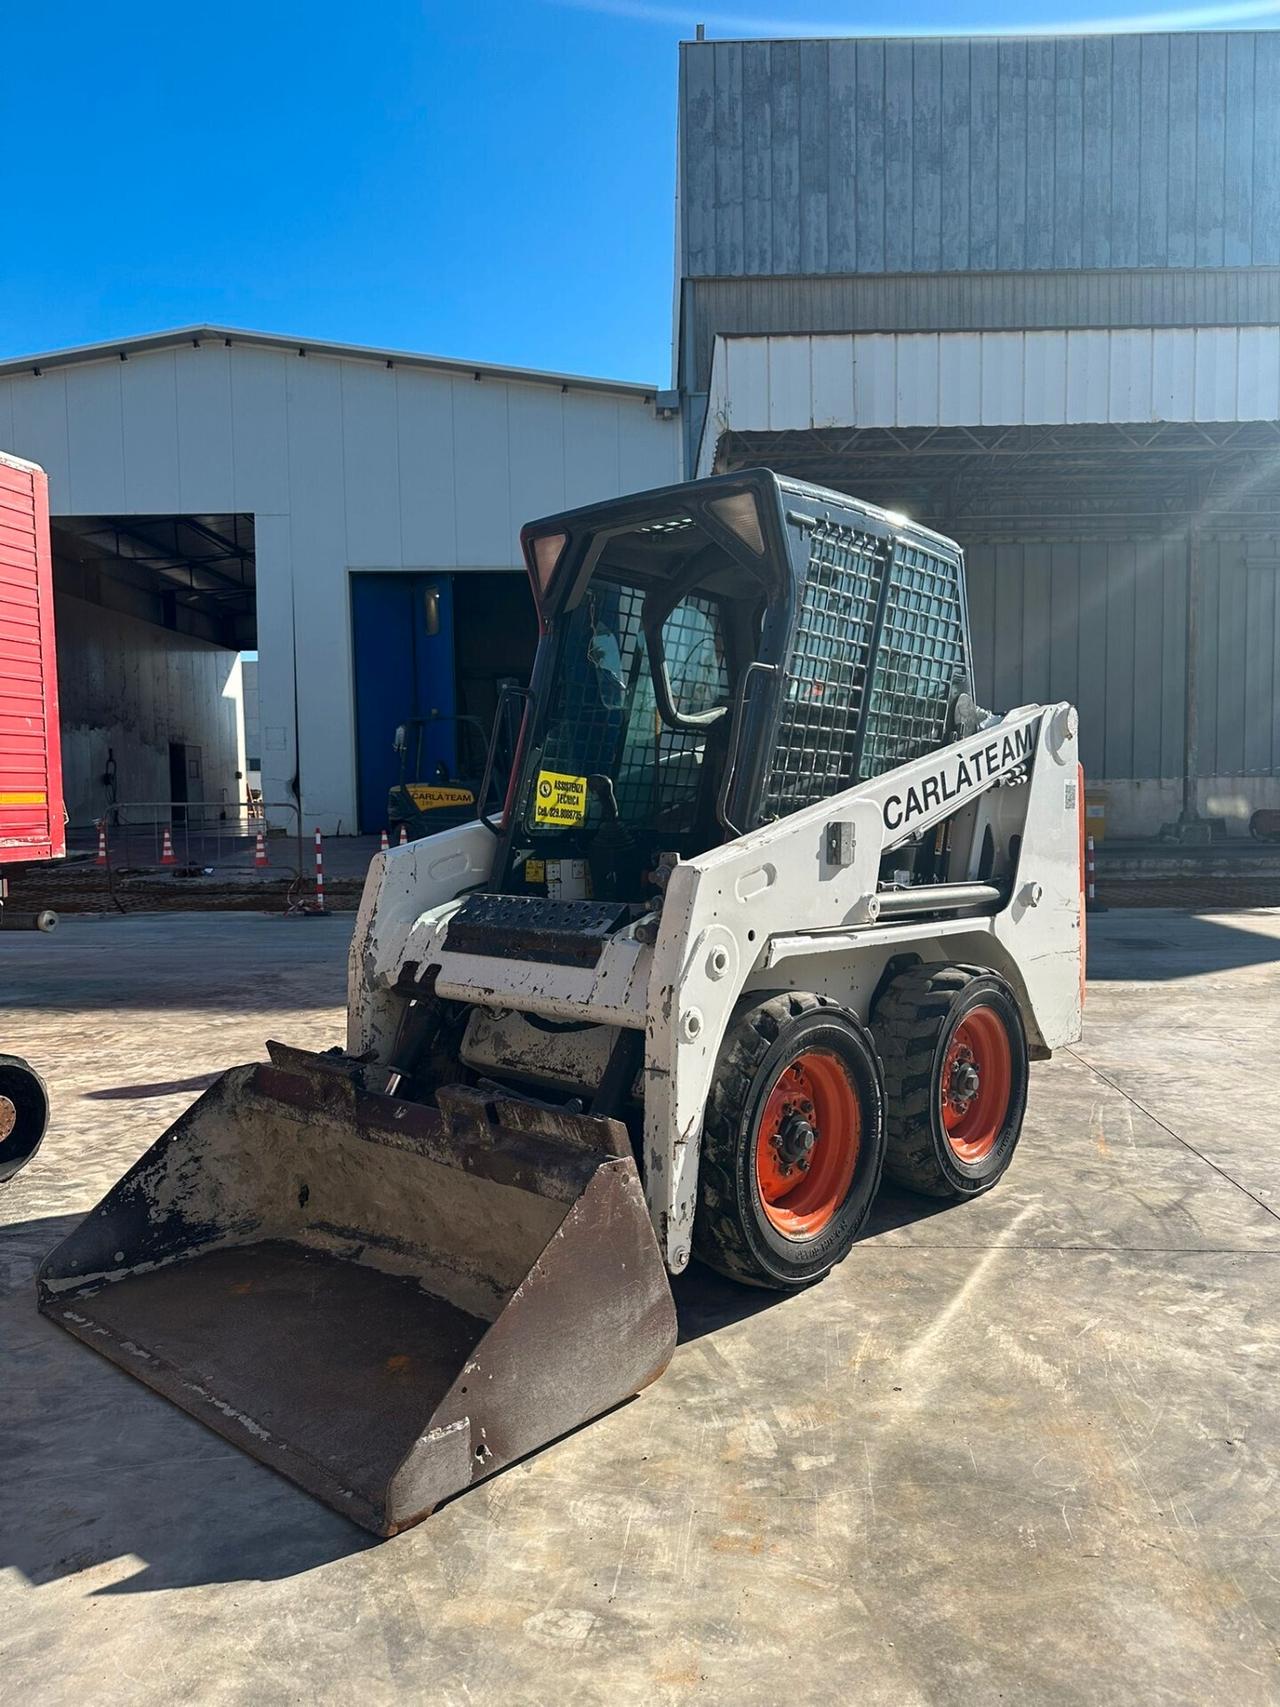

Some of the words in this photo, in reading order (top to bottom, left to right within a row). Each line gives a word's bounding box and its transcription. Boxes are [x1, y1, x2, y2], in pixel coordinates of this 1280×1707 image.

[883, 724, 1033, 830] CARLÀTEAM
[554, 780, 584, 793] ASSISTENZA
[557, 793, 580, 806] TECNICA
